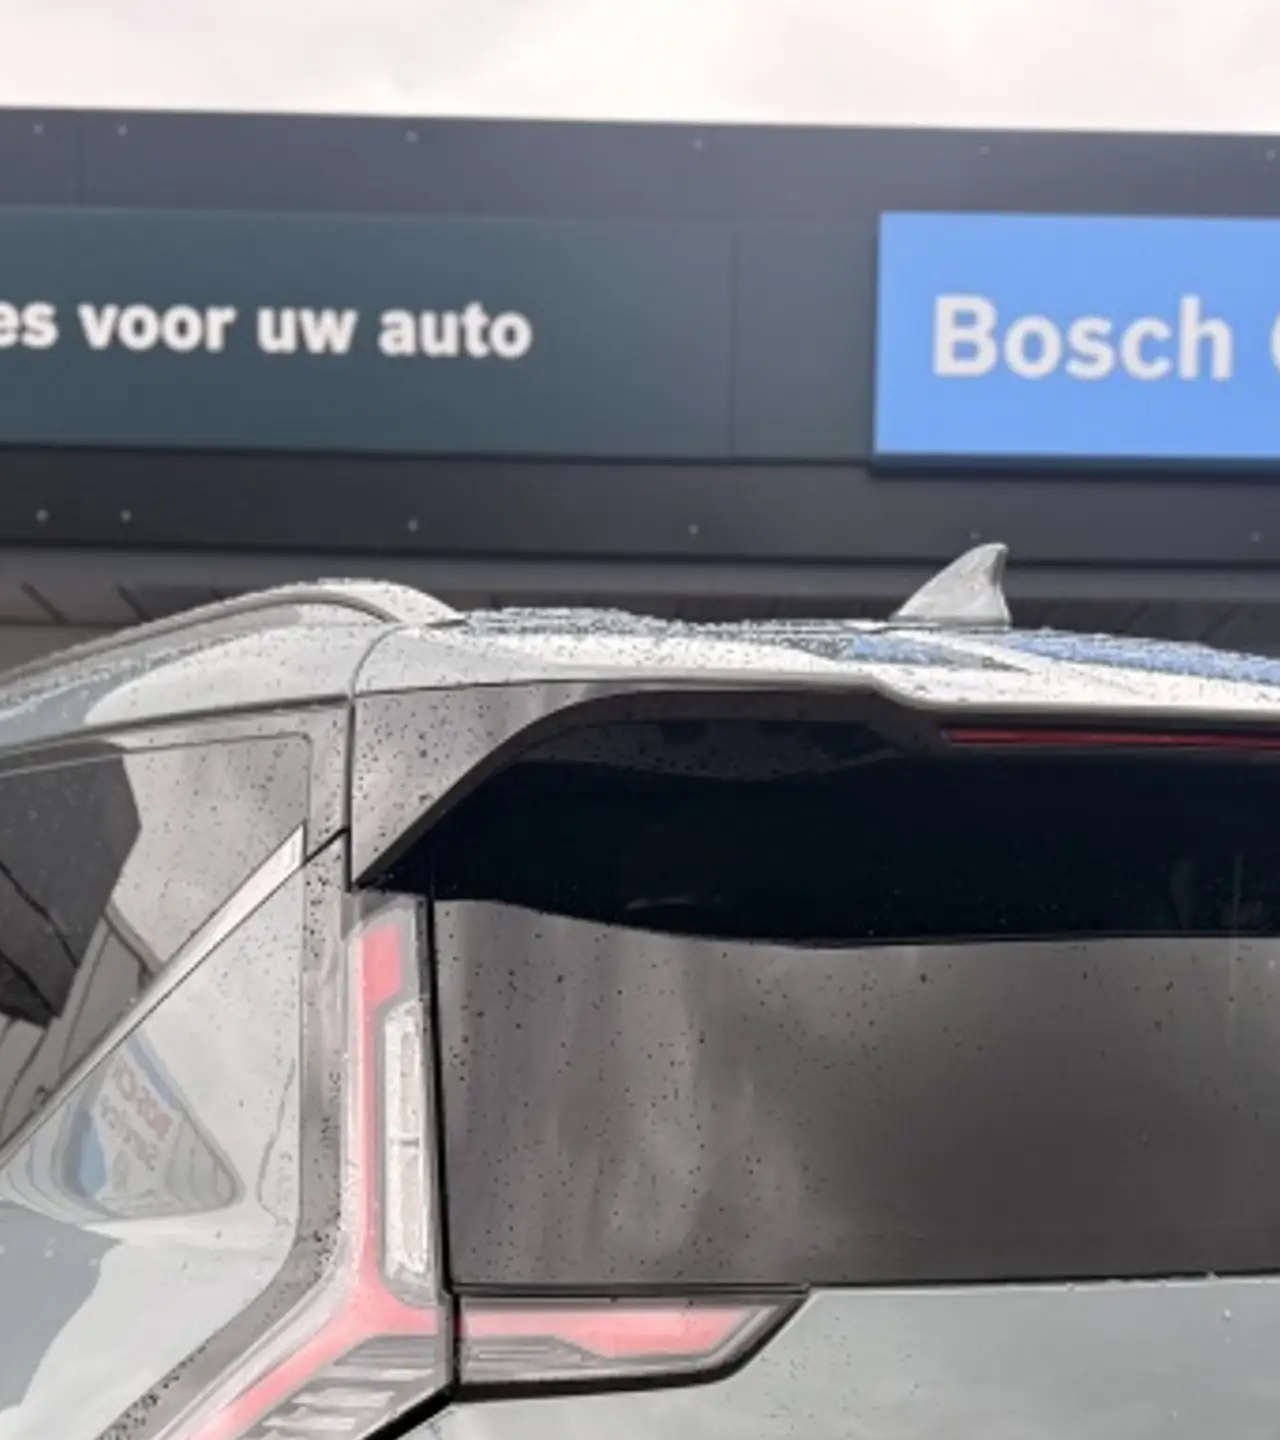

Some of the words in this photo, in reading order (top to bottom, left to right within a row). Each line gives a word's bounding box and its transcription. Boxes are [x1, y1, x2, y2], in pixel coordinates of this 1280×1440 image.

[77, 302, 237, 352] voor
[256, 305, 358, 355] uw
[377, 300, 533, 359] auto
[932, 293, 1234, 381] Bosch
